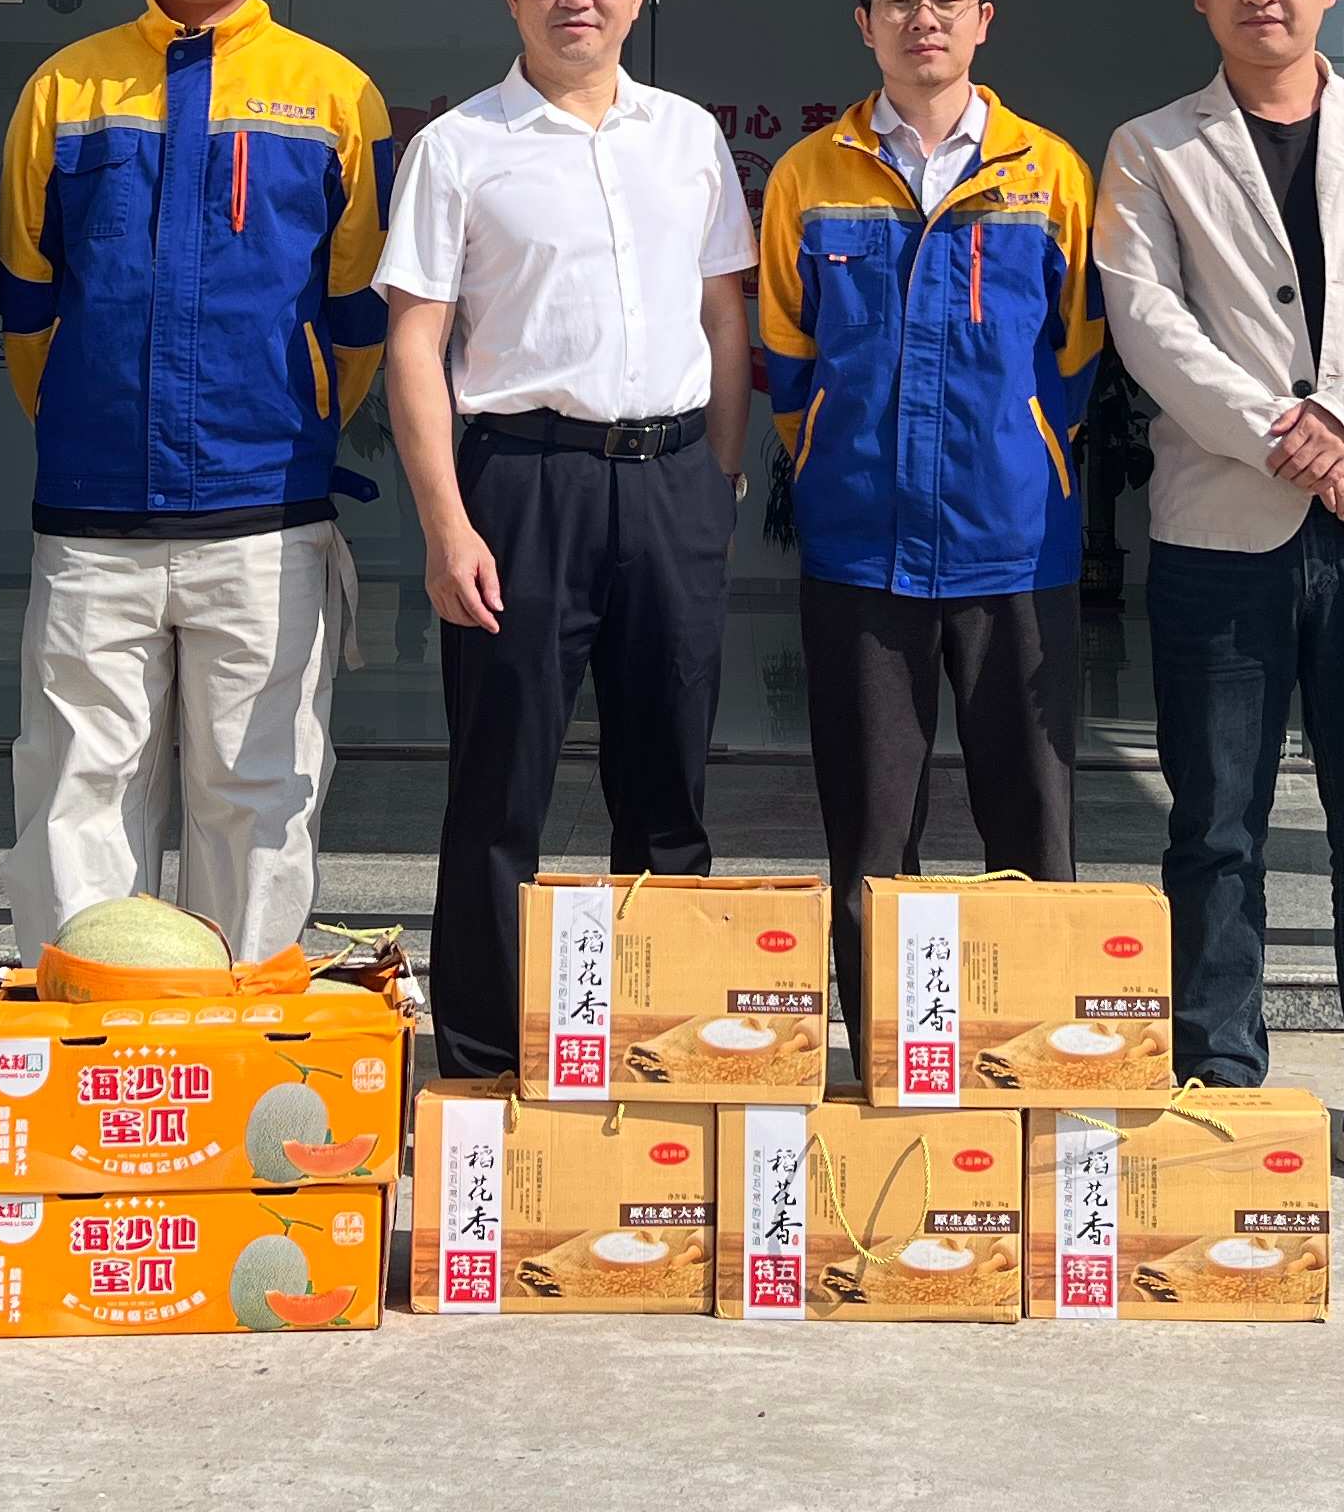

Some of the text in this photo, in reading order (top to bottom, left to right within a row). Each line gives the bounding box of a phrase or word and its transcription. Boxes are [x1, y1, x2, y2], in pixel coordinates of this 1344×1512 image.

[571, 929, 607, 1024] 稻花香
[919, 937, 956, 1032] 稻花香
[78, 1065, 211, 1103] 海沙地
[101, 1108, 187, 1145] 蜜瓜
[70, 1216, 197, 1252] 海沙地
[461, 1144, 498, 1240] 稻花香
[765, 1148, 802, 1245] 稻花香
[1077, 1151, 1114, 1245] 稻花香
[91, 1257, 174, 1294] 蜜瓜
